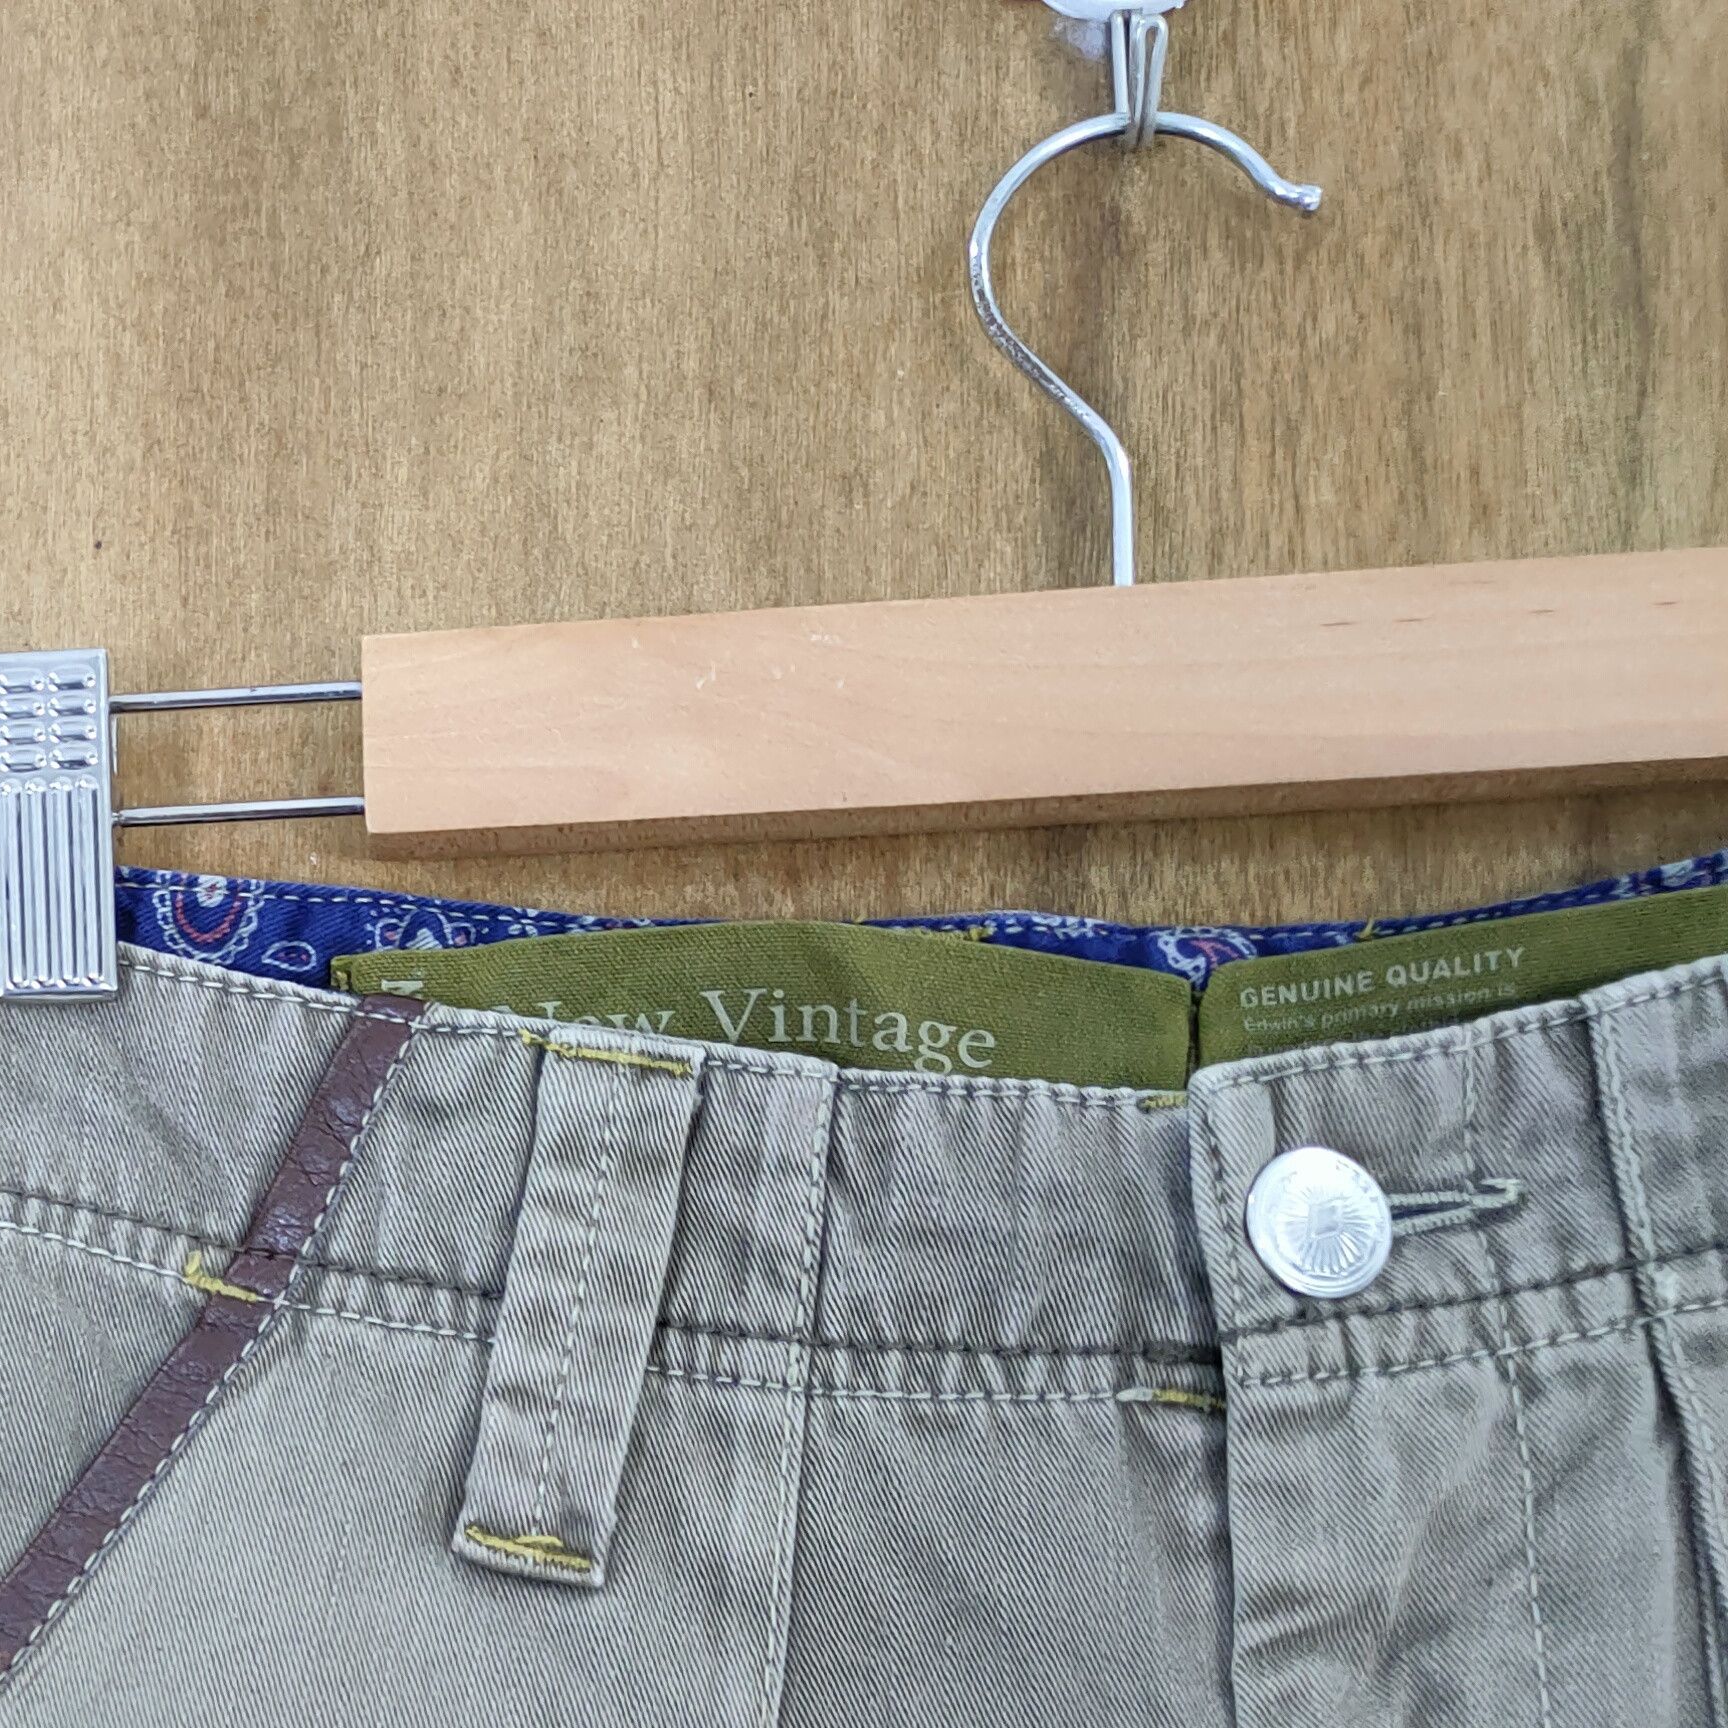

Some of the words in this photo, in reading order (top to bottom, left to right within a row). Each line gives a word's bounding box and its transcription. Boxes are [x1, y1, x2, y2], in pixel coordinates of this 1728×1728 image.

[1240, 970, 1375, 1008] GENUINE
[1385, 946, 1525, 988] QUALITY
[700, 988, 996, 1075] Vintage
